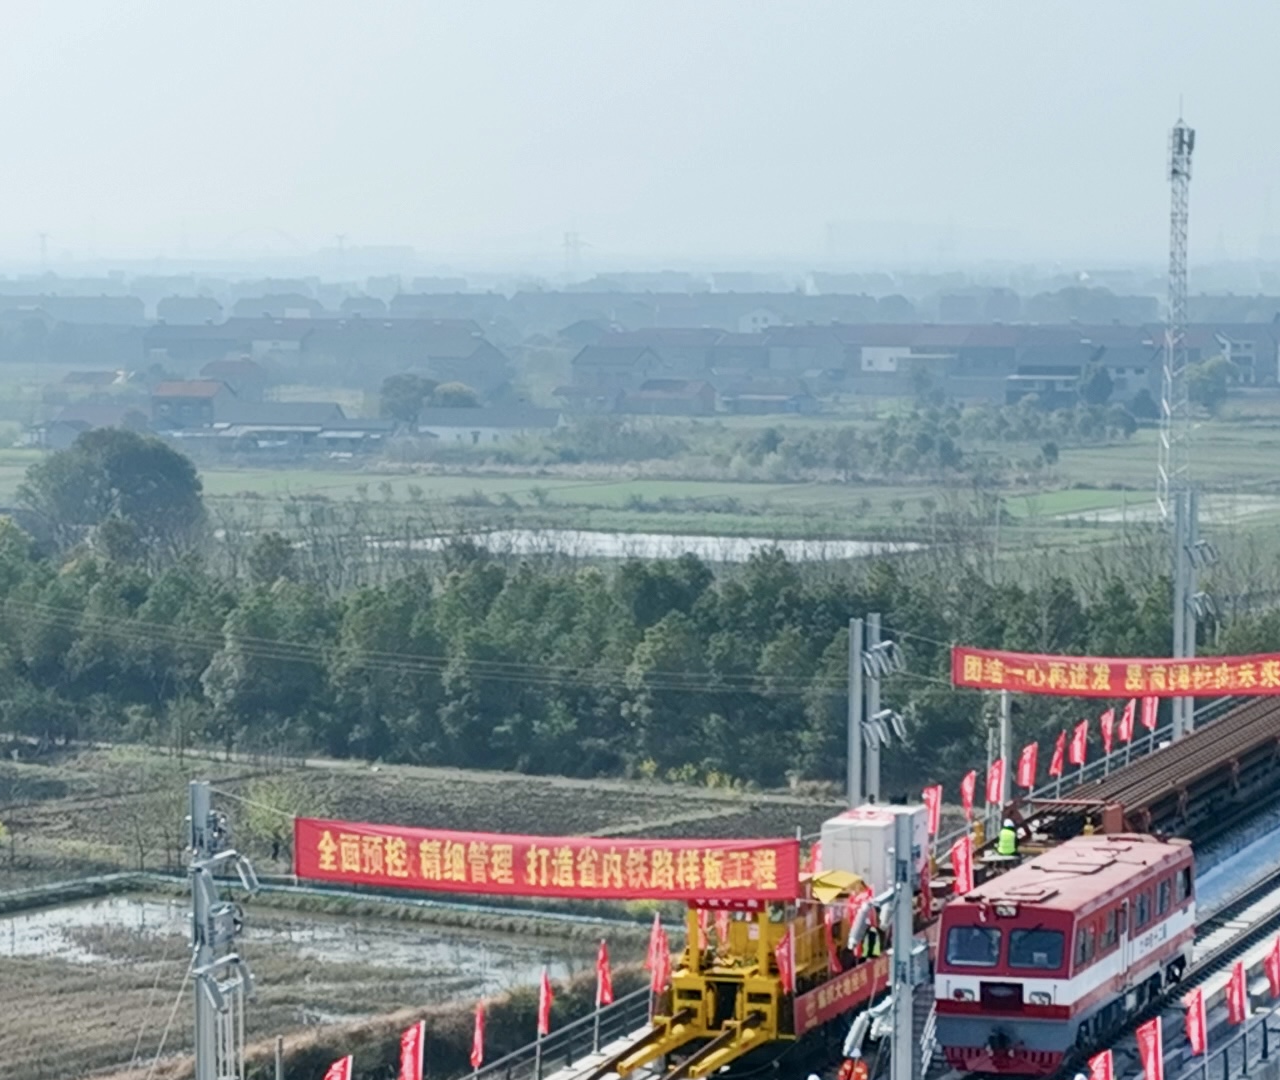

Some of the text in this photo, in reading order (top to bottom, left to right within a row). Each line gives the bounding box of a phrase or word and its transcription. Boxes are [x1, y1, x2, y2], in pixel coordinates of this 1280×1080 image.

[317, 830, 779, 891] 全面预控 精细管理 打造省内铁路样板工程
